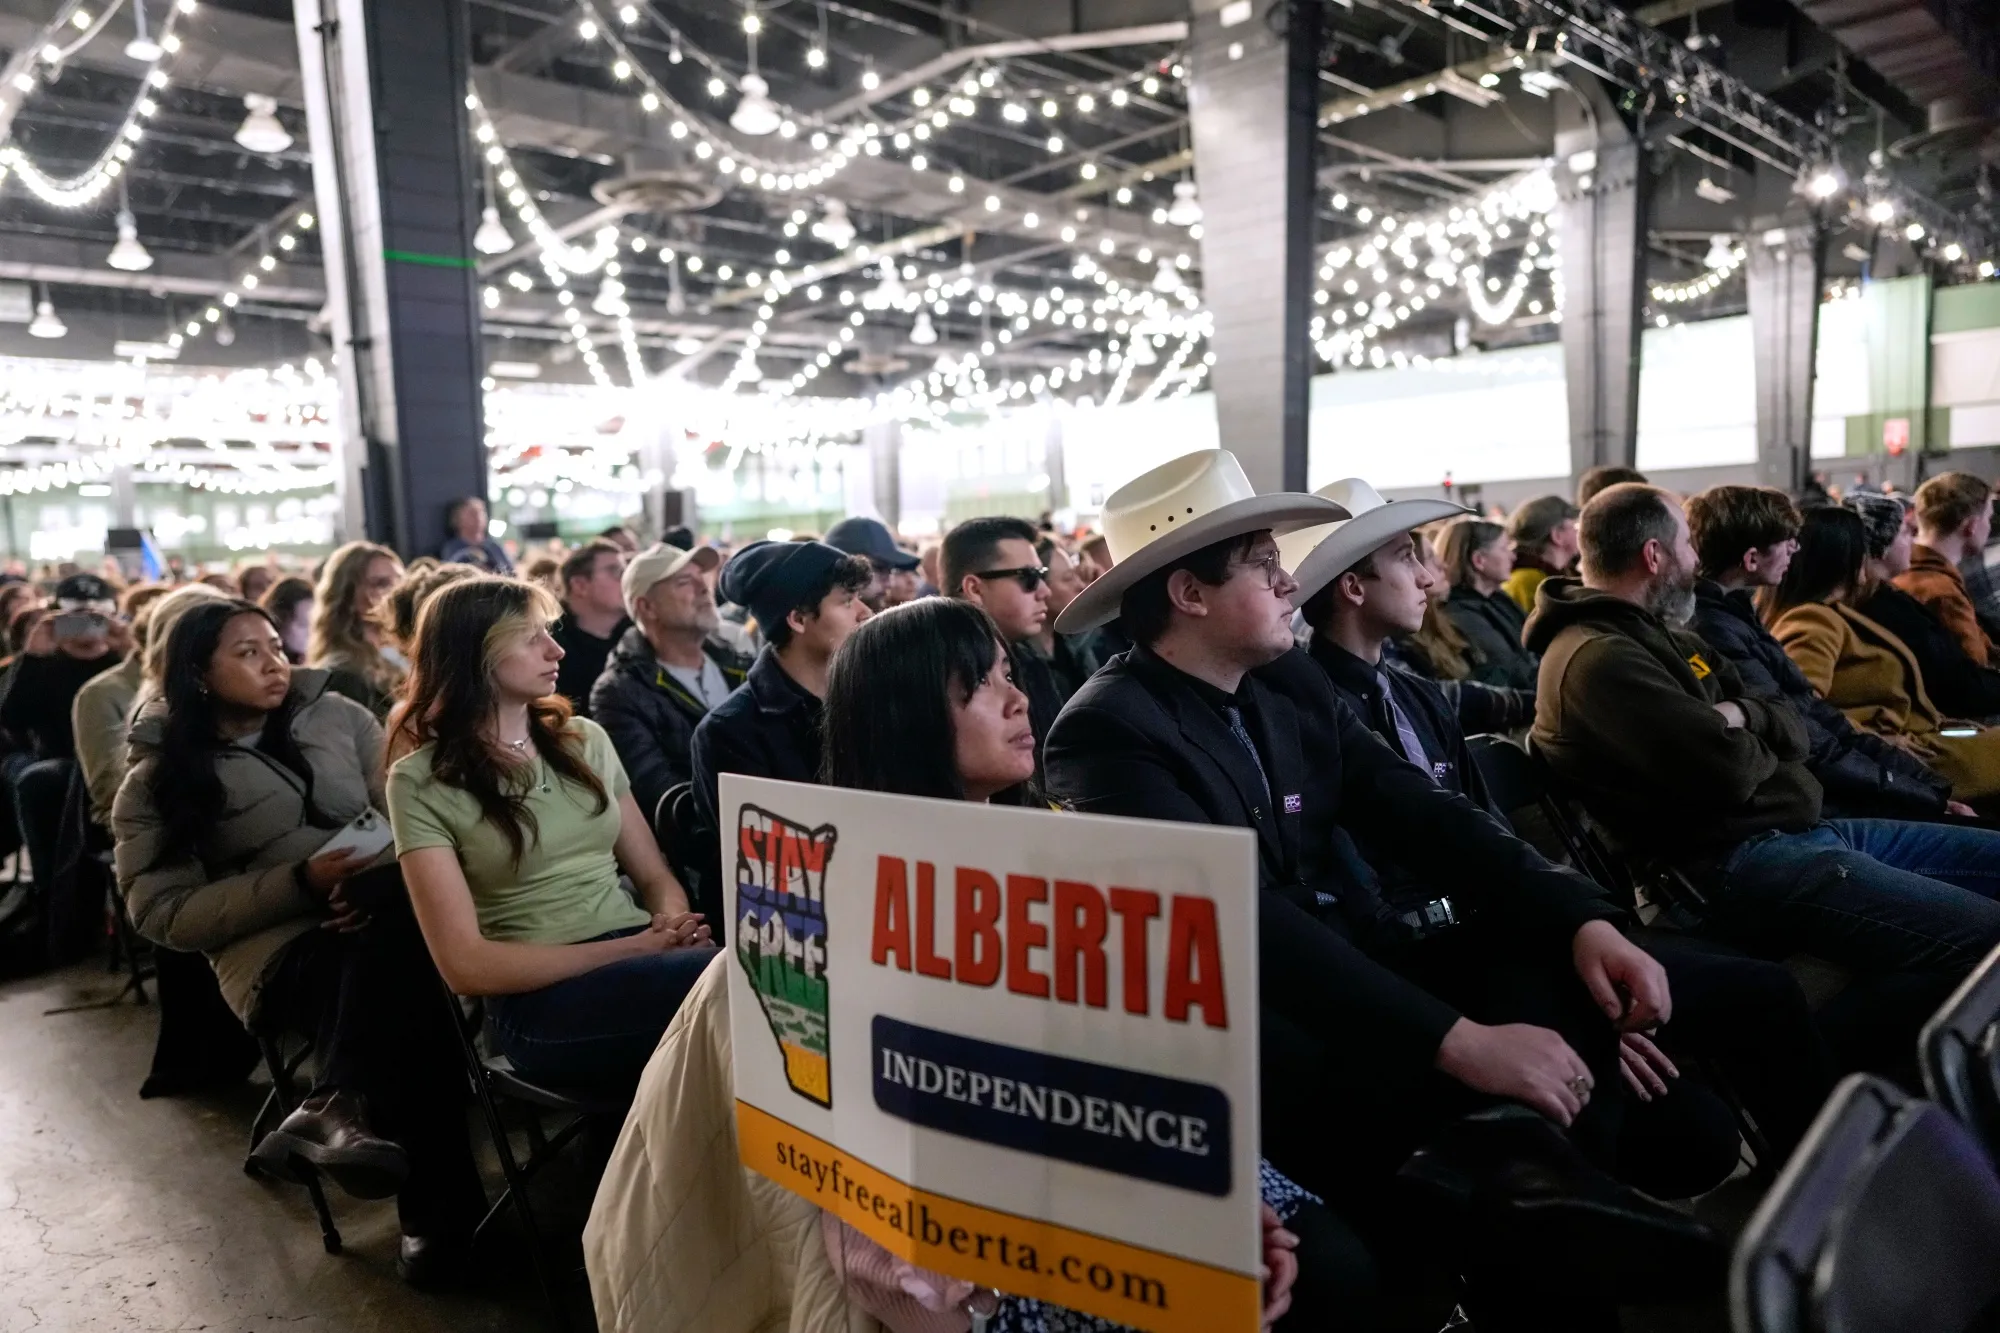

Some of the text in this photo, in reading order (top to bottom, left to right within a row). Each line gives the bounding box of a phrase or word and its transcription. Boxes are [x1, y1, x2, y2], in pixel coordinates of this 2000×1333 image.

[1285, 796, 1300, 808] PPC
[738, 809, 835, 916] STAY
[737, 896, 826, 1000] FREE
[871, 854, 1229, 1030] ALBERTA
[881, 1047, 1210, 1156] INDEPENDENCE
[776, 1140, 1169, 1309] stayfreealberta.com
